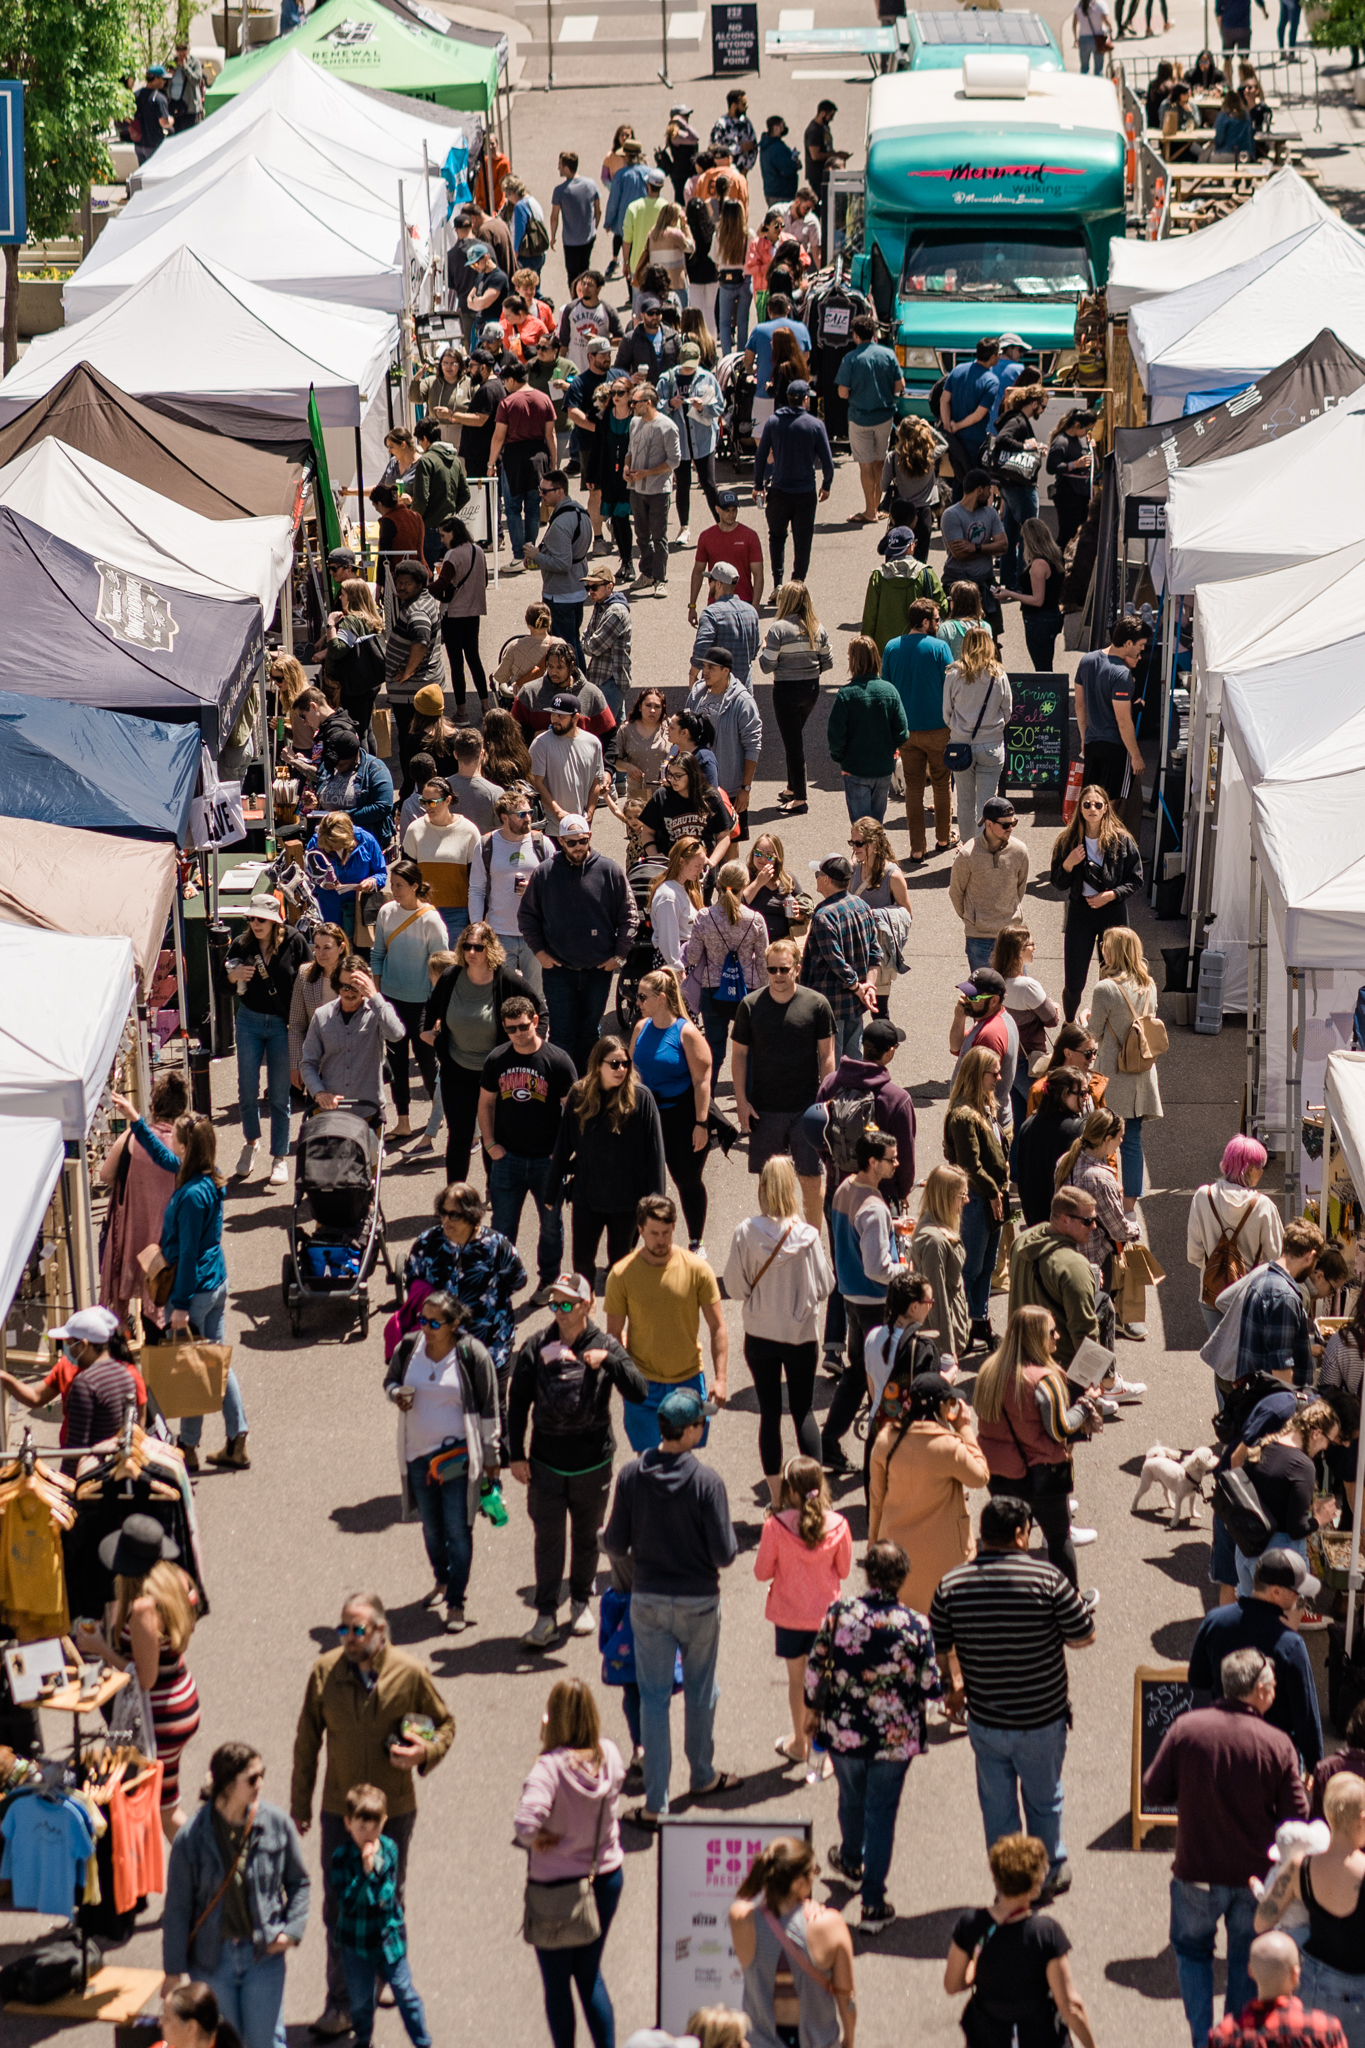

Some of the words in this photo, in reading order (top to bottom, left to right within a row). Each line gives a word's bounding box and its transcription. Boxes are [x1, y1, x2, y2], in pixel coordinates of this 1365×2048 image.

[728, 23, 742, 32] NO
[715, 31, 755, 41] ALCOHOL
[718, 40, 753, 49] BEYOND
[312, 50, 381, 60] RENEWAL
[727, 49, 746, 57] THIS
[723, 56, 750, 66] POINT
[951, 162, 1047, 184] Mermaid
[1012, 183, 1062, 198] walking
[572, 311, 605, 327] AKATSUKI
[825, 313, 848, 326] SALE
[1010, 681, 1060, 704] Spring
[1010, 704, 1049, 723] Sale
[319, 795, 354, 807] ALONE
[506, 1066, 539, 1078] NATIONAL
